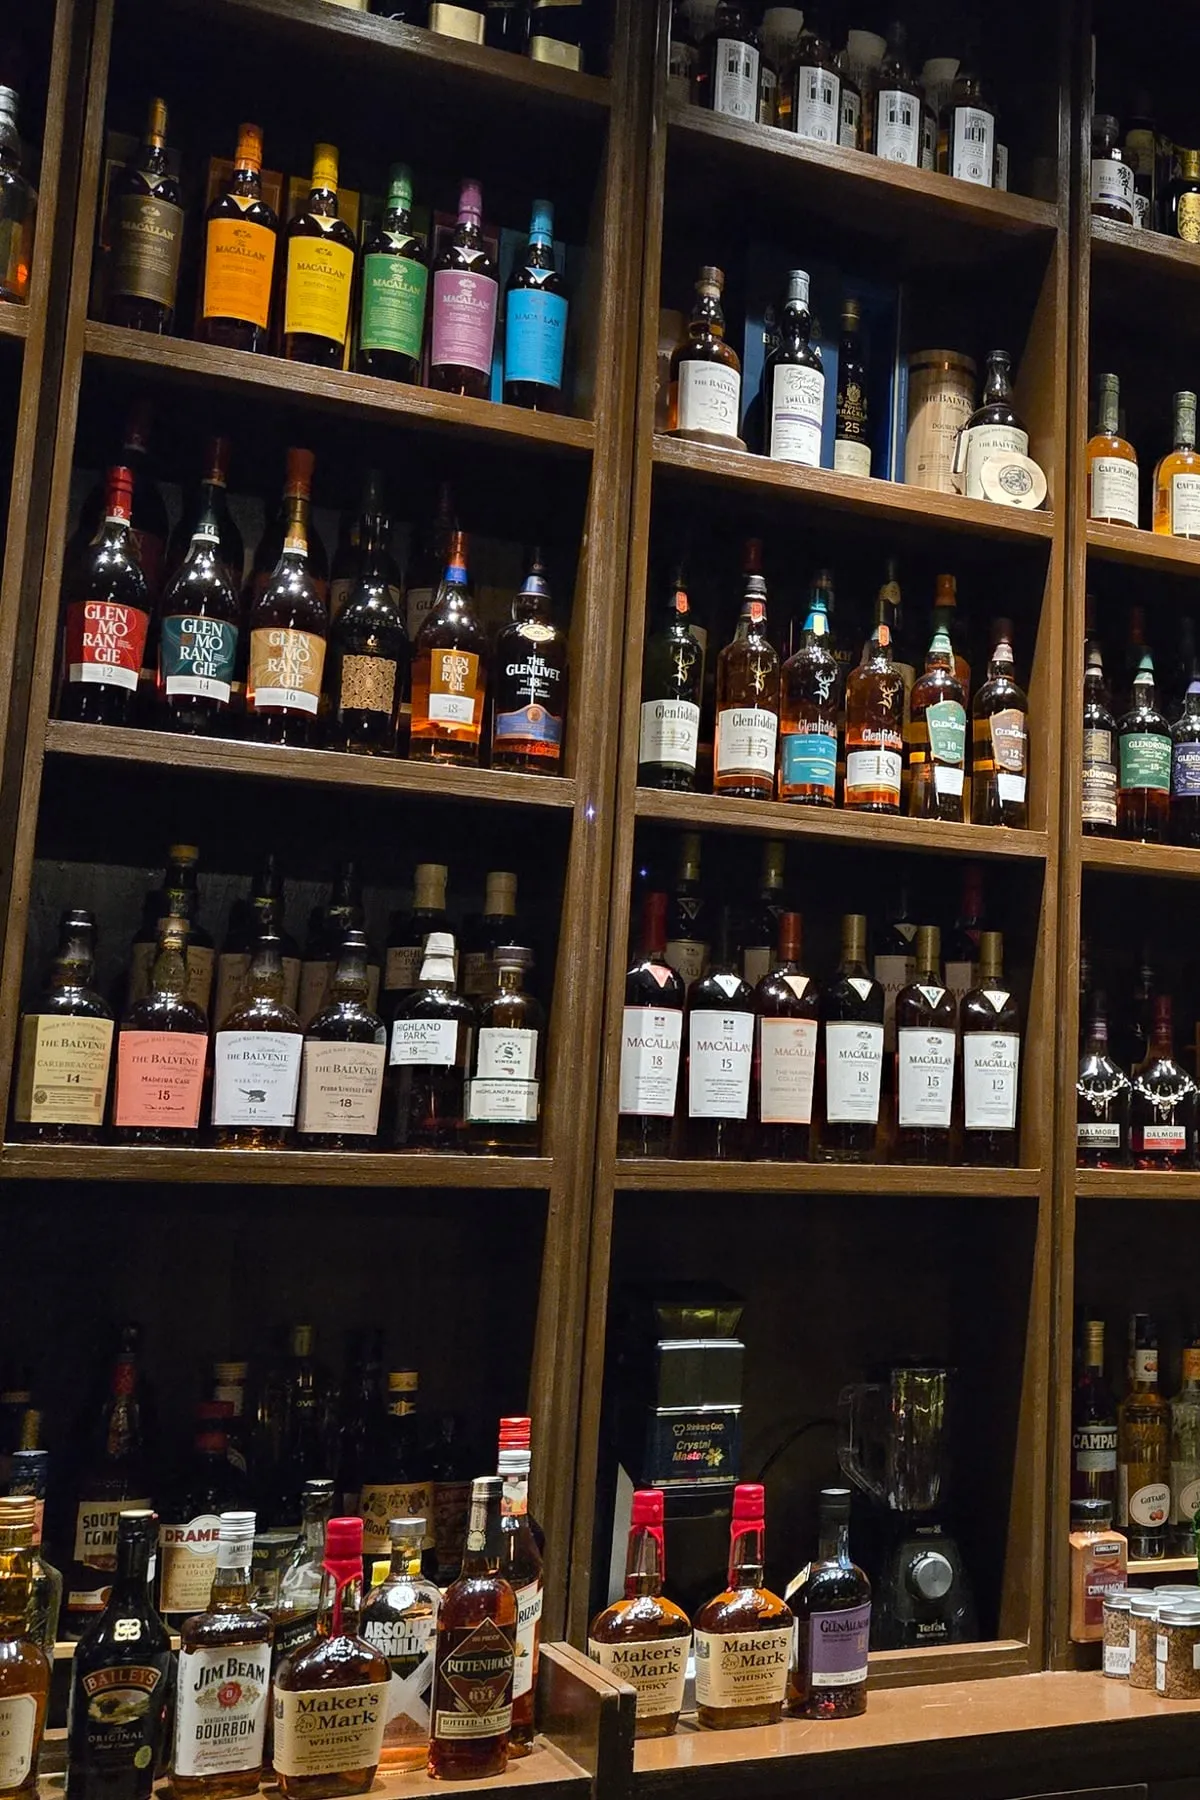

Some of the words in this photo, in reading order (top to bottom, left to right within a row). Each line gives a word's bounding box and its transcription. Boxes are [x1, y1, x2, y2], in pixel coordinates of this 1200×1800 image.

[296, 262, 346, 280] MACALLAN
[844, 421, 860, 434] 25
[84, 604, 128, 622] GLEN
[97, 620, 128, 637] MO
[180, 618, 224, 637] GLEN
[83, 632, 118, 648] RAN
[194, 634, 224, 650] MO
[268, 632, 310, 648] GLEN
[94, 647, 120, 664] GIE
[180, 646, 212, 662] RAN
[280, 646, 310, 663] MO
[442, 654, 470, 668] GLEN
[192, 661, 216, 678] GIE
[268, 658, 299, 674] RAN
[505, 664, 561, 682] GLENLIVET
[279, 674, 304, 688] GIE
[442, 671, 463, 682] RAN
[449, 682, 466, 692] GIE
[1008, 749, 1019, 758] 12
[396, 1022, 441, 1032] HIGHLAND
[403, 1032, 427, 1040] PARK
[41, 1039, 58, 1048] THE
[226, 1052, 241, 1061] THE
[408, 1046, 418, 1056] 18
[132, 1054, 148, 1064] THE
[652, 1055, 662, 1066] 18
[722, 1058, 732, 1069] 15
[314, 1065, 331, 1074] THE
[858, 1071, 870, 1082] 18
[66, 1073, 80, 1084] 14
[926, 1076, 940, 1087] 15
[992, 1079, 1004, 1090] 12
[158, 1090, 170, 1101] 15
[340, 1098, 352, 1108] 18
[1080, 1128, 1117, 1136] DALMORE
[676, 1440, 712, 1452] Crystal
[672, 1450, 706, 1462] Master
[82, 1514, 120, 1529] SOUT
[1088, 1582, 1125, 1595] CINNAMON
[364, 1620, 433, 1640] ABSOLUT
[722, 1636, 787, 1654] Maker's
[611, 1646, 681, 1664] Maker's
[740, 1652, 785, 1668] Mark
[447, 1654, 514, 1673] RITTENHOUSE
[86, 1666, 160, 1690] BAILEYS
[194, 1664, 226, 1692] JIM
[227, 1658, 265, 1685] BEAM
[630, 1662, 680, 1680] Mark
[732, 1672, 775, 1683] WHISKY
[296, 1692, 378, 1714] Maker's
[316, 1709, 377, 1730] Mark
[196, 1718, 256, 1740] BOURBON
[88, 1732, 144, 1742] ORIGINAL
[308, 1733, 363, 1748] WHISKY
